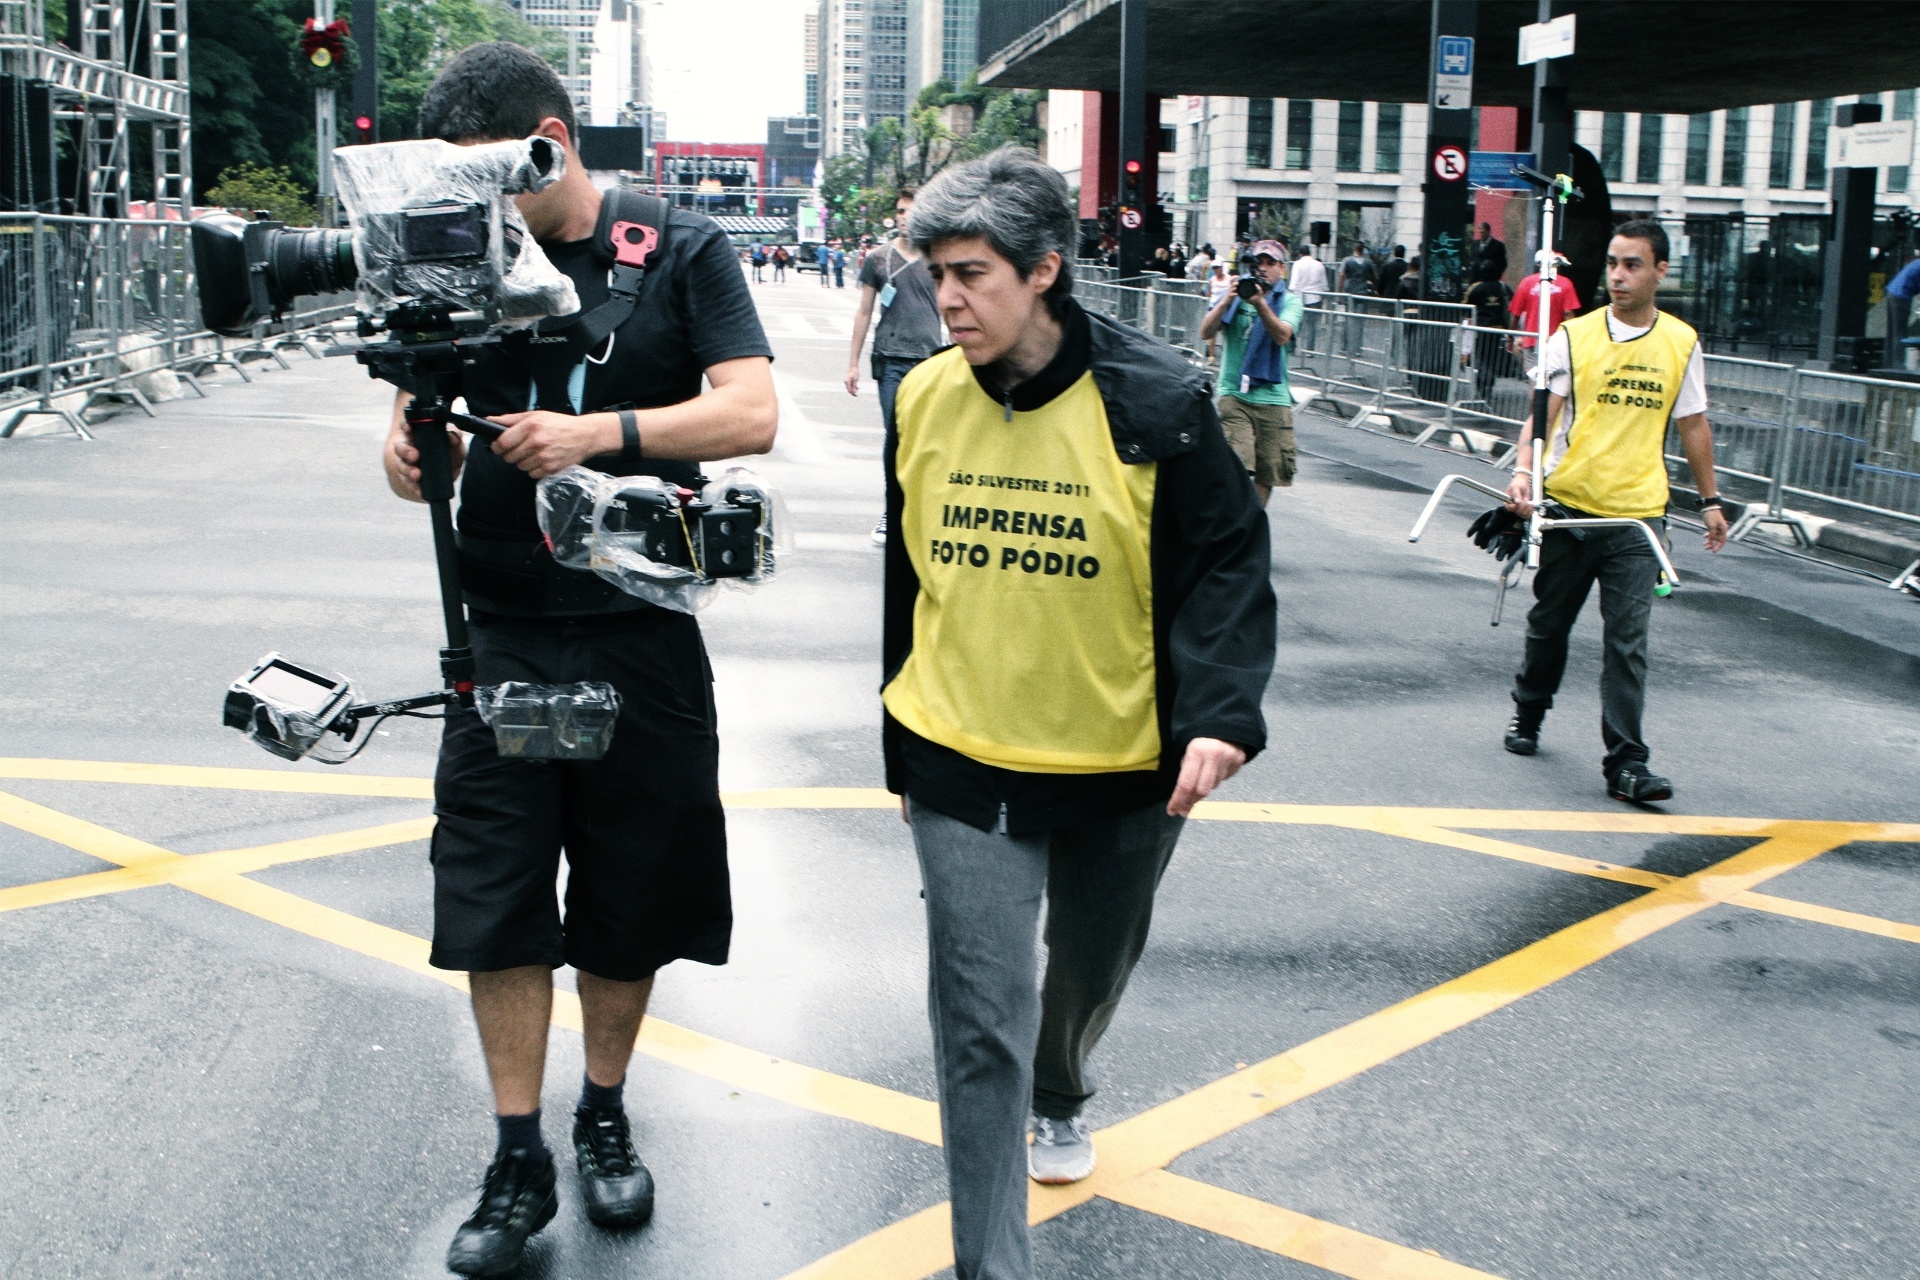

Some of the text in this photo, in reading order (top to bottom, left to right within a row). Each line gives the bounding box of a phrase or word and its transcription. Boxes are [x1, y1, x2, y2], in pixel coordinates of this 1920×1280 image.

[949, 470, 1090, 498] SÃO SILVESTRE 2011
[943, 504, 1087, 542] IMPRENSA
[931, 539, 1100, 579] FOTO PÓDIO
